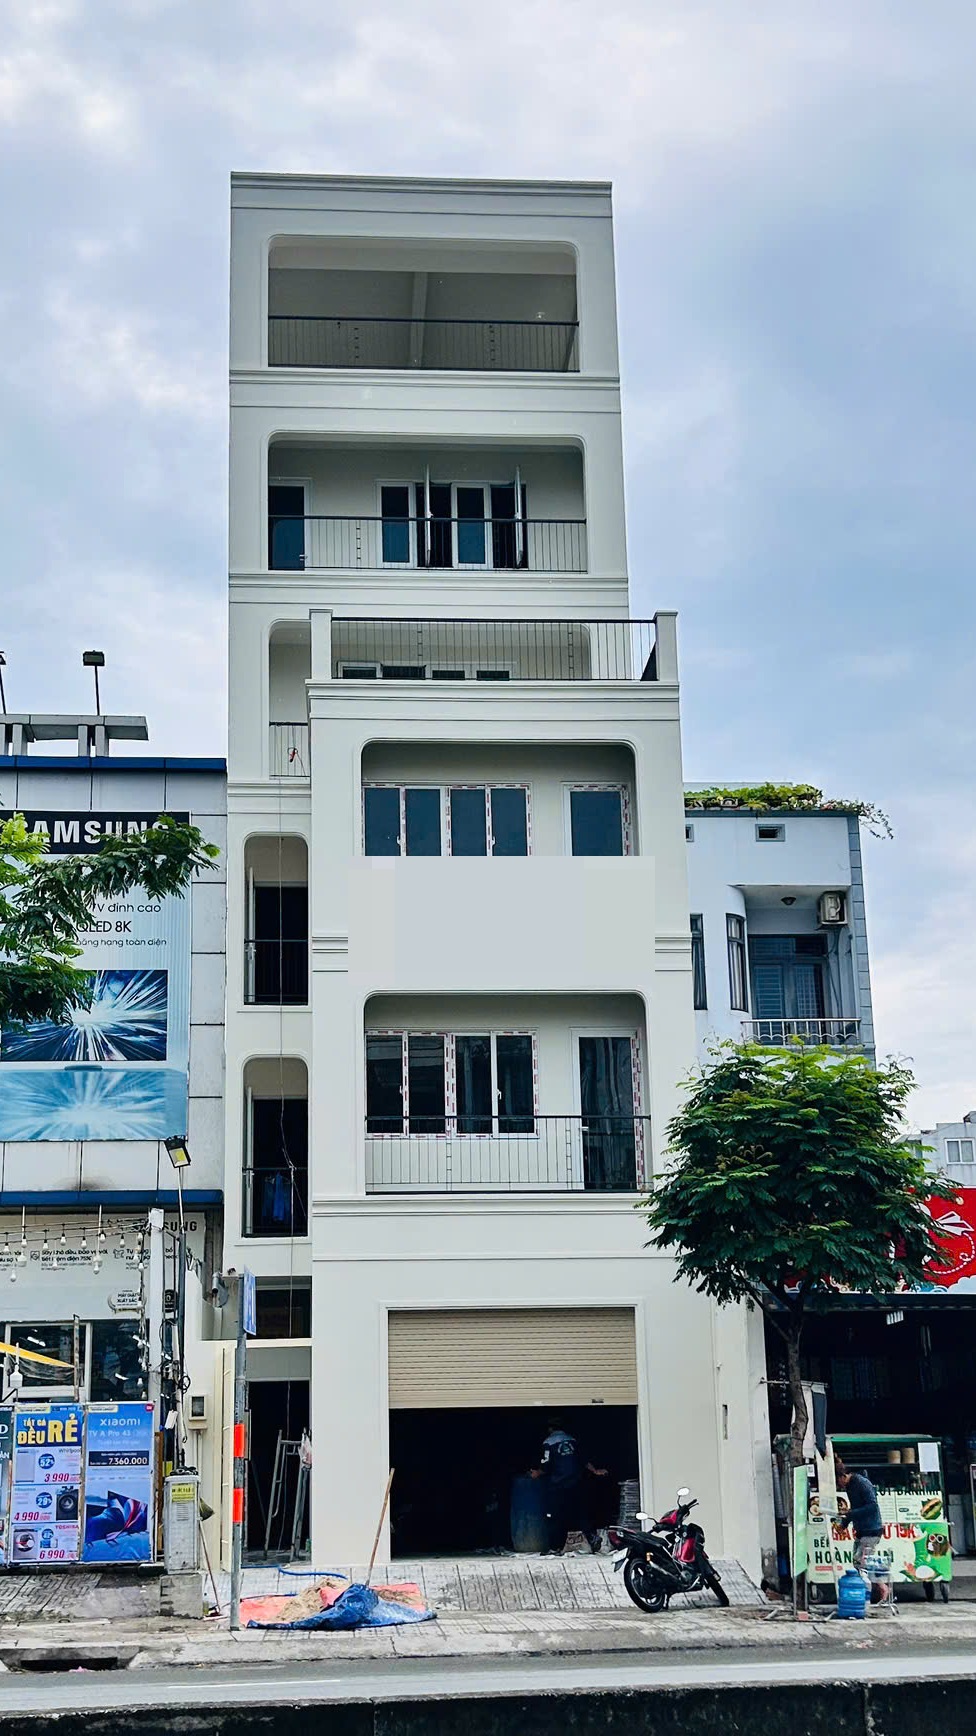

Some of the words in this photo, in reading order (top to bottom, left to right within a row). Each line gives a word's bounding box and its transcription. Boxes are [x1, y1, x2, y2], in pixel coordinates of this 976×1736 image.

[115, 921, 132, 932] 8K
[17, 1426, 45, 1444] ĐỀU
[48, 1413, 78, 1442] RẺ
